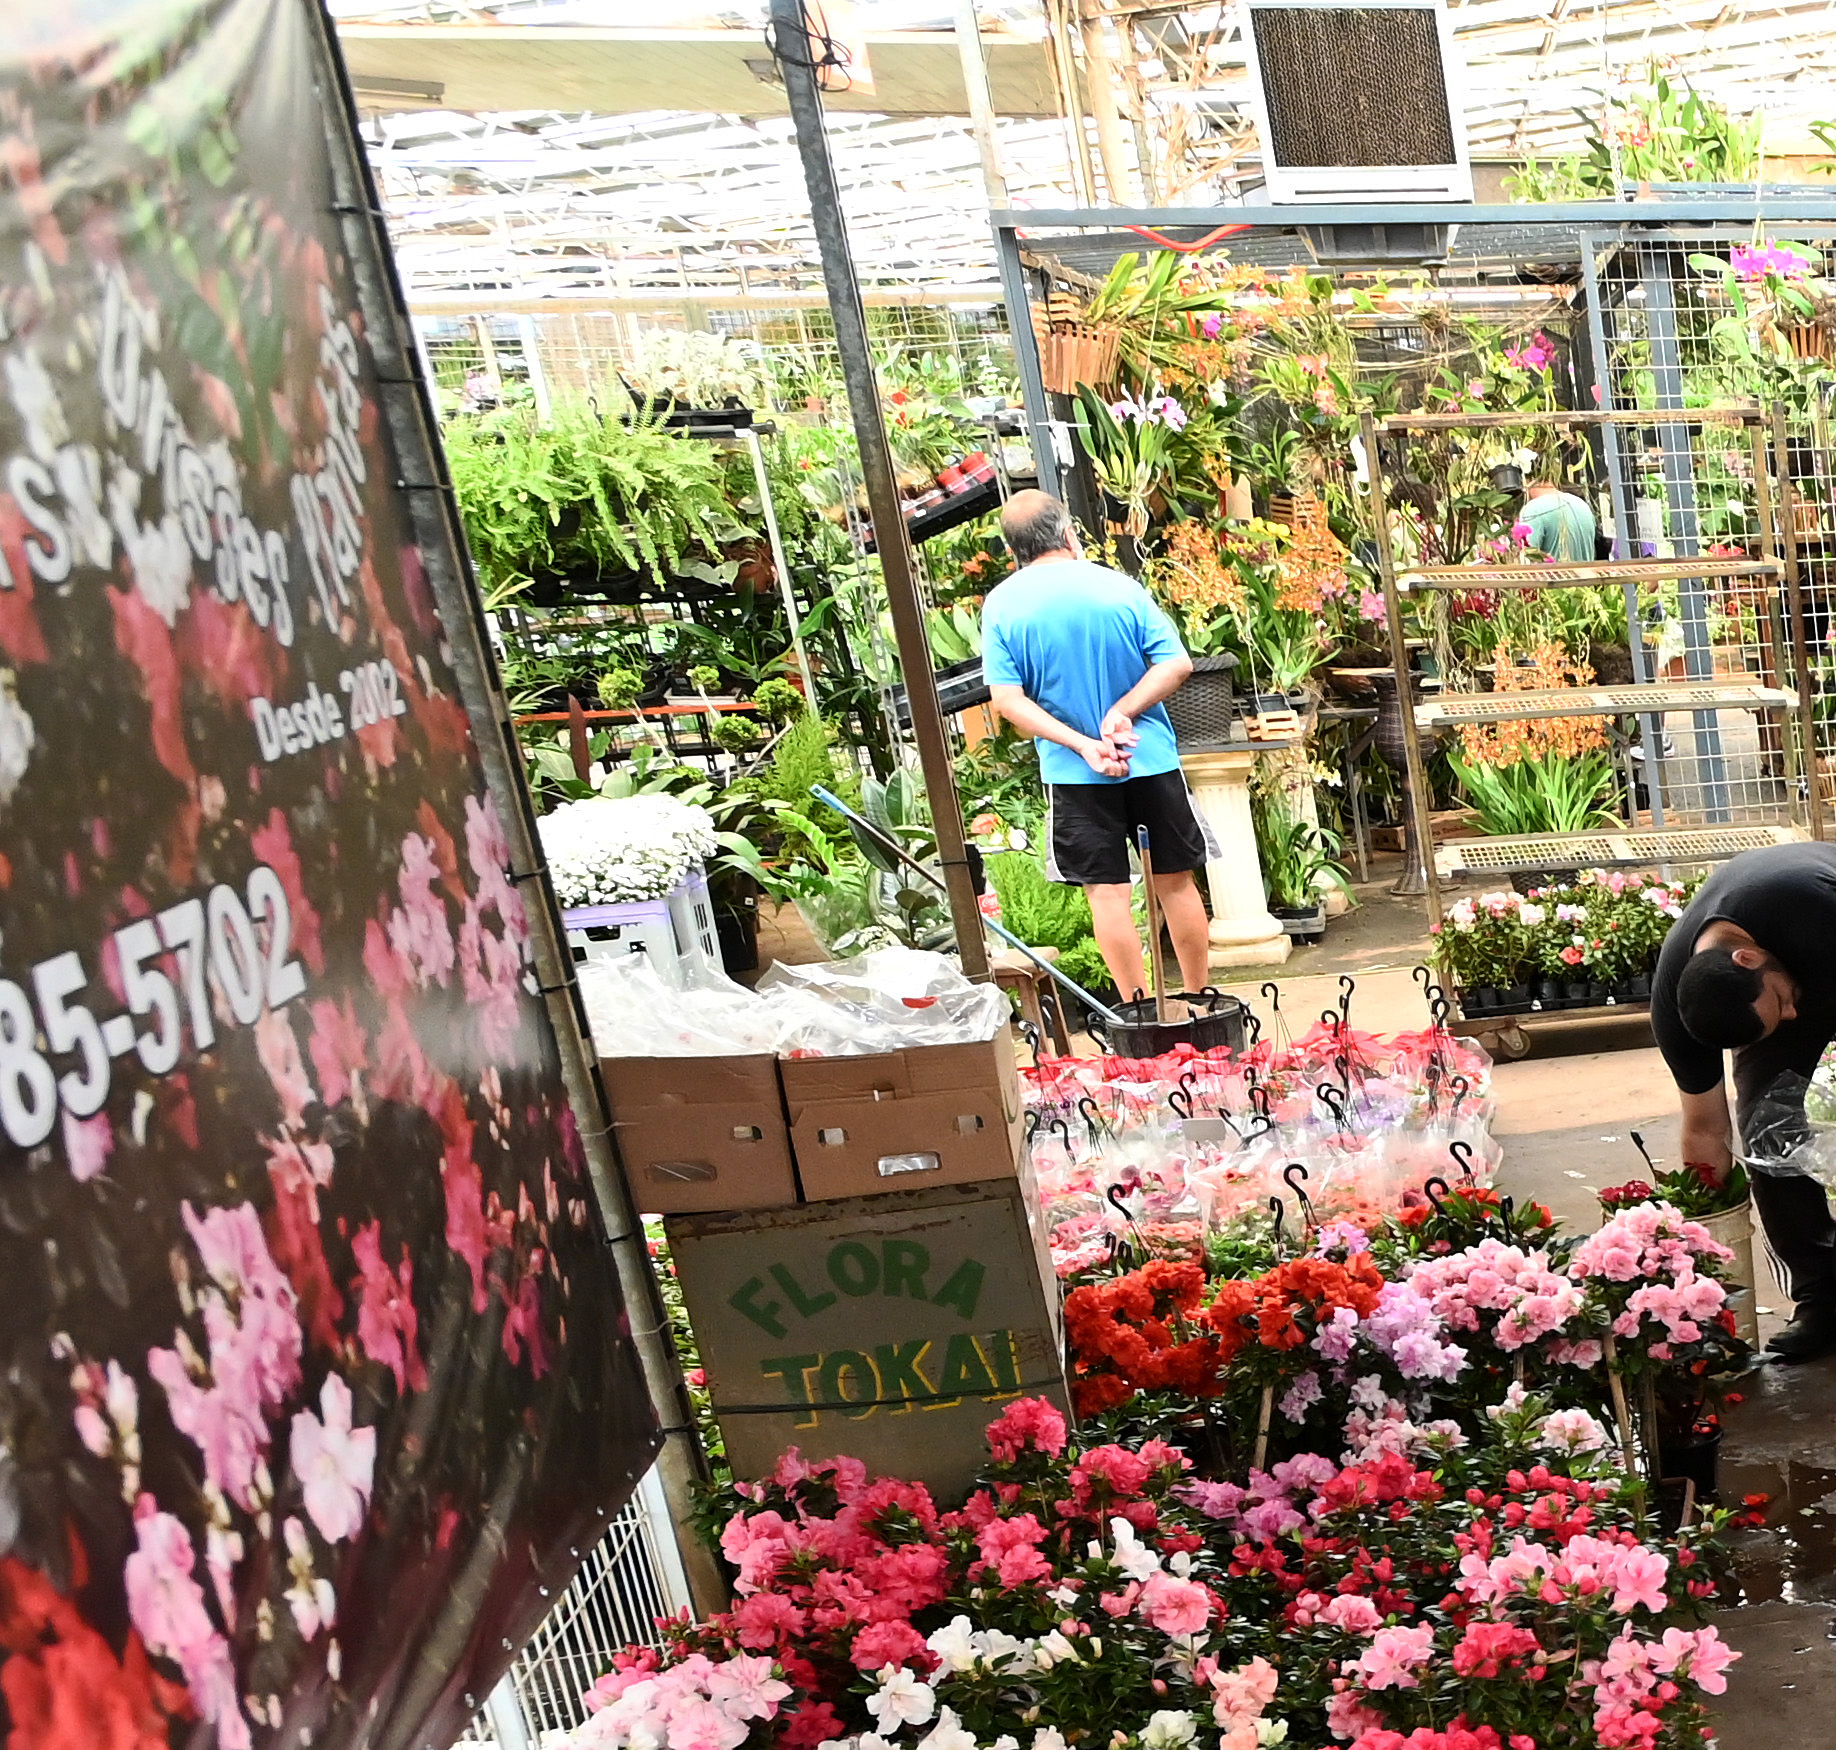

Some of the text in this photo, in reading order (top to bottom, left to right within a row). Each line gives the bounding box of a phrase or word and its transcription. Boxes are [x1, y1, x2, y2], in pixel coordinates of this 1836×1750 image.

[251, 658, 406, 762] Desde 2002
[730, 1239, 986, 1340] FLORA
[760, 1328, 1024, 1430] TOKAI
